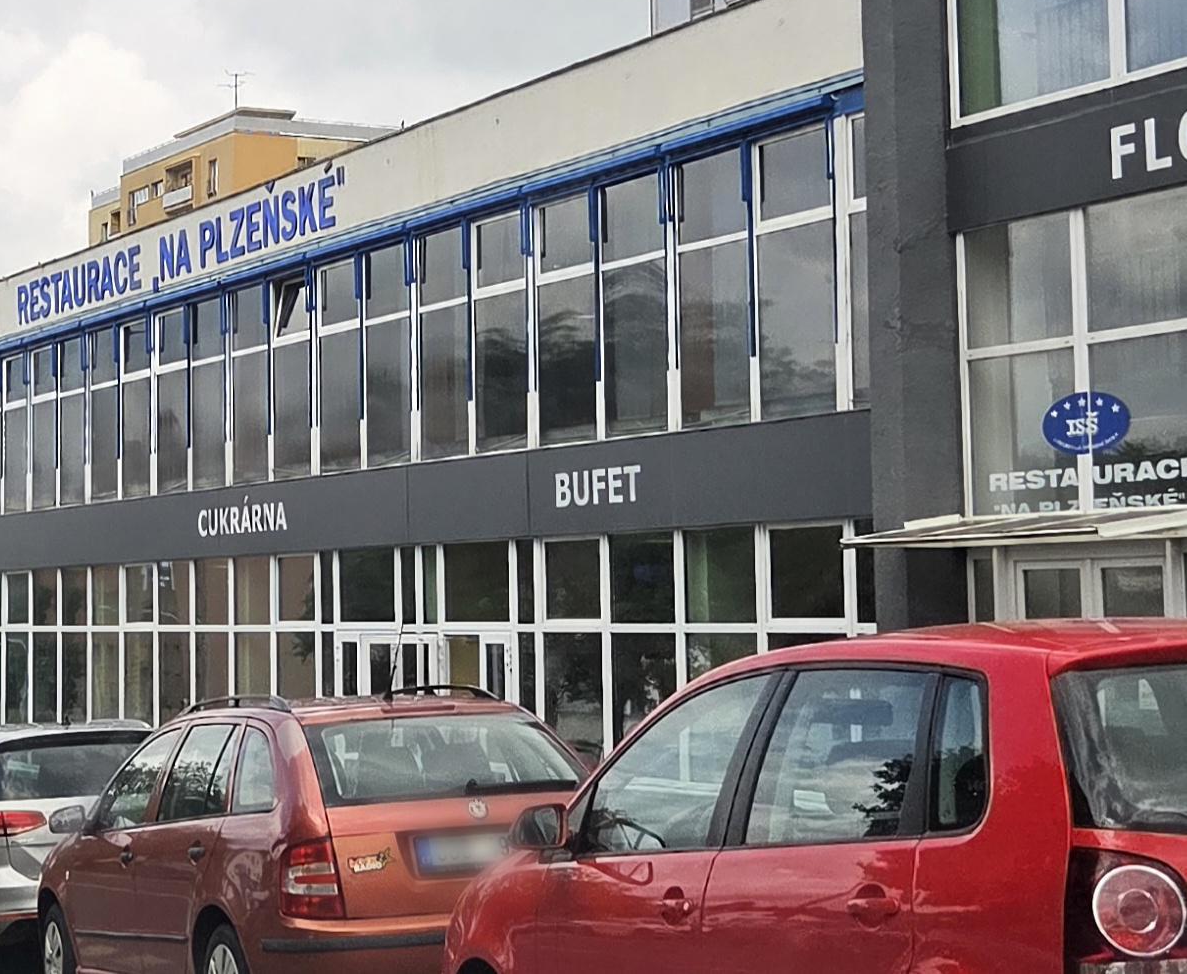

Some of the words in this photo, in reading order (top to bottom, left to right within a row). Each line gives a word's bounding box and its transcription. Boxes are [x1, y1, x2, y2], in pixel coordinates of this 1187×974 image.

[1110, 111, 1187, 180] FL
[16, 244, 142, 326] RESTAURACE
[1065, 411, 1099, 438] ISŠ
[555, 465, 641, 508] BUFET
[198, 495, 287, 538] CUKRÁRNA
